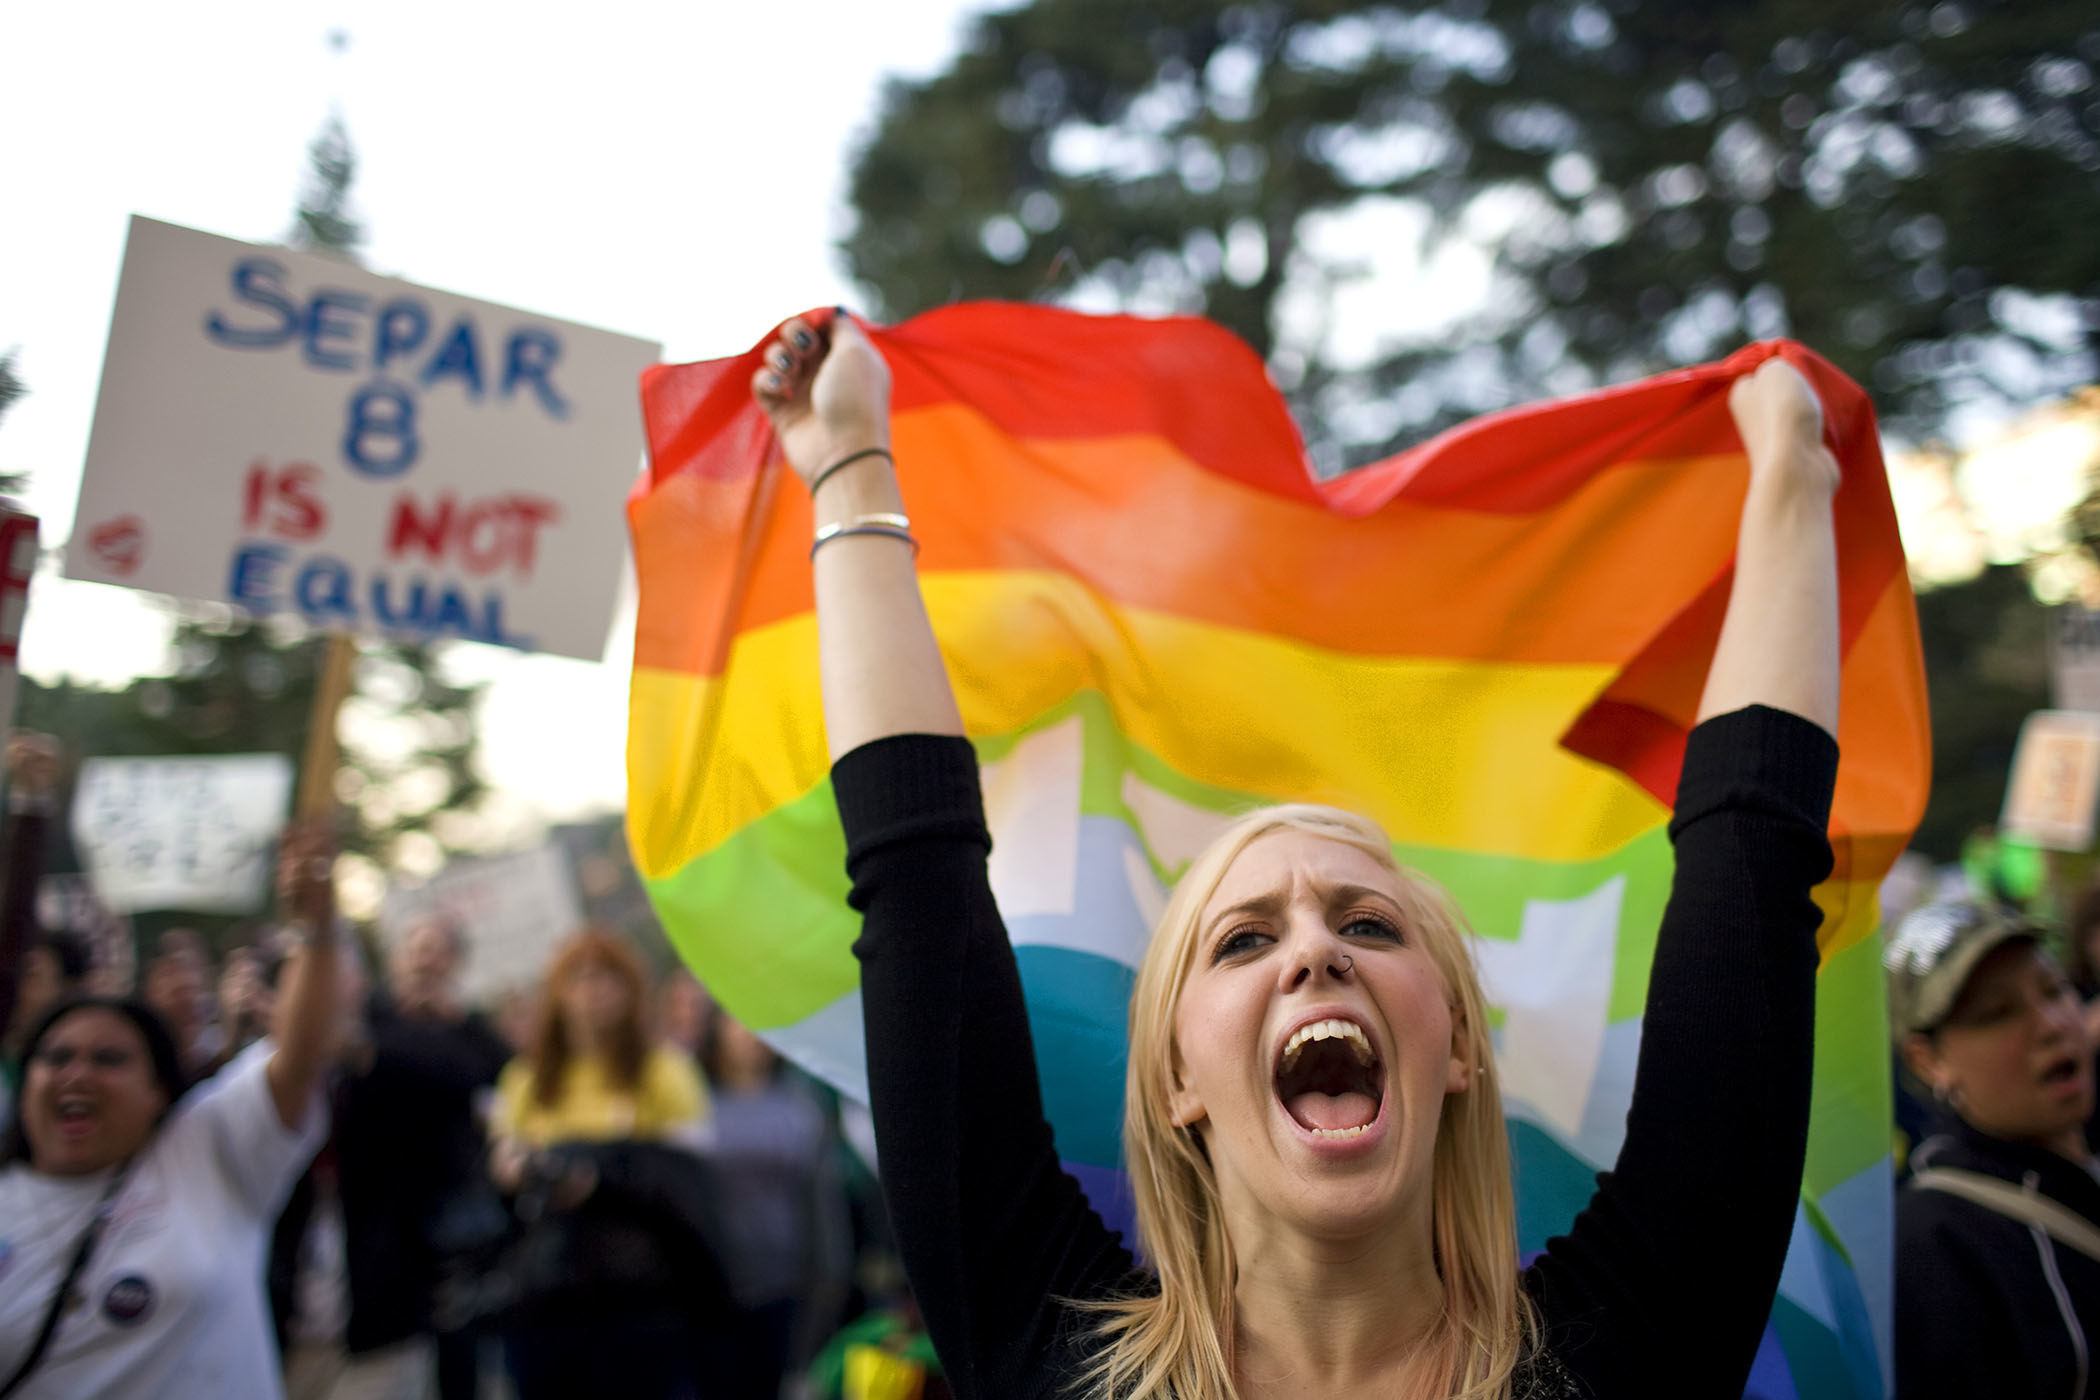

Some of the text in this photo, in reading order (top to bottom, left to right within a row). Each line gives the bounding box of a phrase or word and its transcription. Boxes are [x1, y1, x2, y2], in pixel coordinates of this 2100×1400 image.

[205, 256, 572, 422] SEPAR
[341, 380, 421, 479] 8
[241, 461, 562, 580] IS NOT
[228, 543, 537, 652] EQUAL
